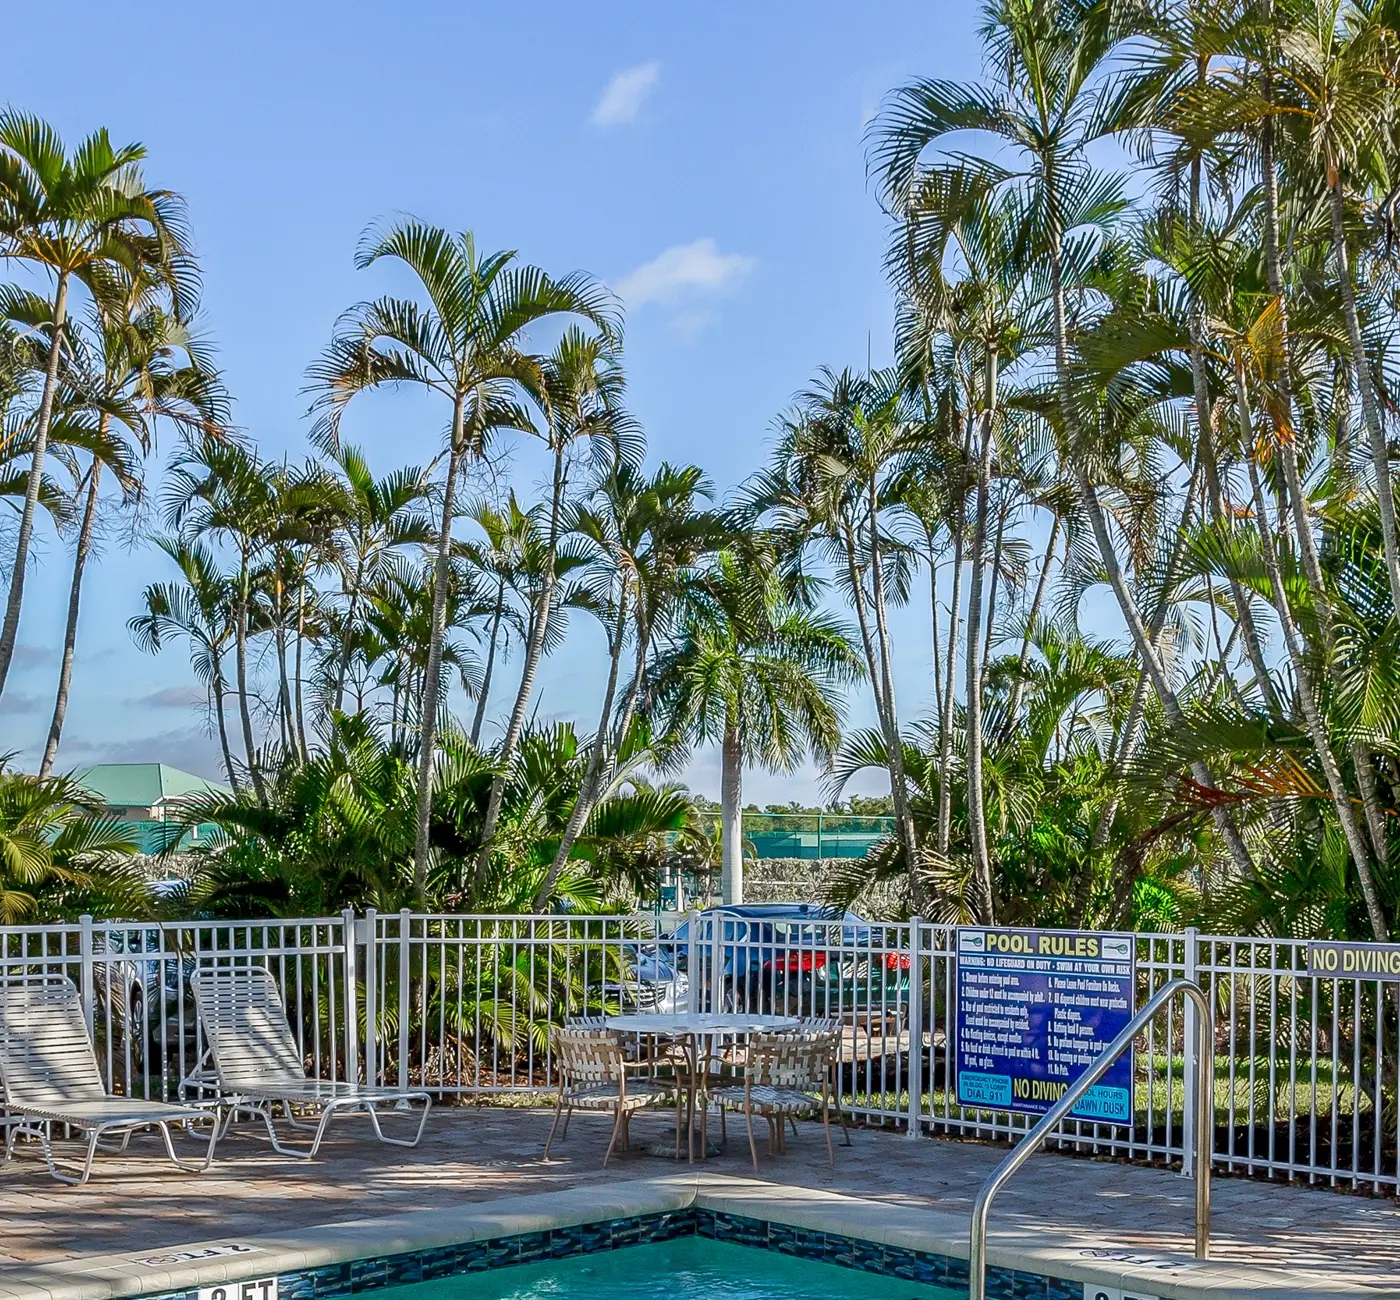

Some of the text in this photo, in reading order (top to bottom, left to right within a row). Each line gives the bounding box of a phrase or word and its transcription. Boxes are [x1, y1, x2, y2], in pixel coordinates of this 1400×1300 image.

[987, 934, 1098, 957] POOL RULES
[960, 956, 985, 966] WARNING:
[987, 958, 994, 967] NO
[996, 958, 1025, 968] LIFEGUARD
[1027, 960, 1034, 969] ON
[1036, 960, 1051, 970] DUTY
[1057, 962, 1072, 971] SWIM
[1074, 963, 1082, 972] AT
[1084, 963, 1099, 973] YOUR
[1101, 964, 1115, 974] OWN
[1116, 965, 1131, 975] RISK
[1313, 949, 1400, 974] NO DIVING
[967, 1088, 1003, 1101] DIAL 911
[1014, 1078, 1029, 1098] NO
[1098, 1091, 1123, 1100] HOURS
[1075, 1100, 1097, 1112] DAWN
[1104, 1102, 1125, 1115] DUSK
[180, 1250, 221, 1259] FT
